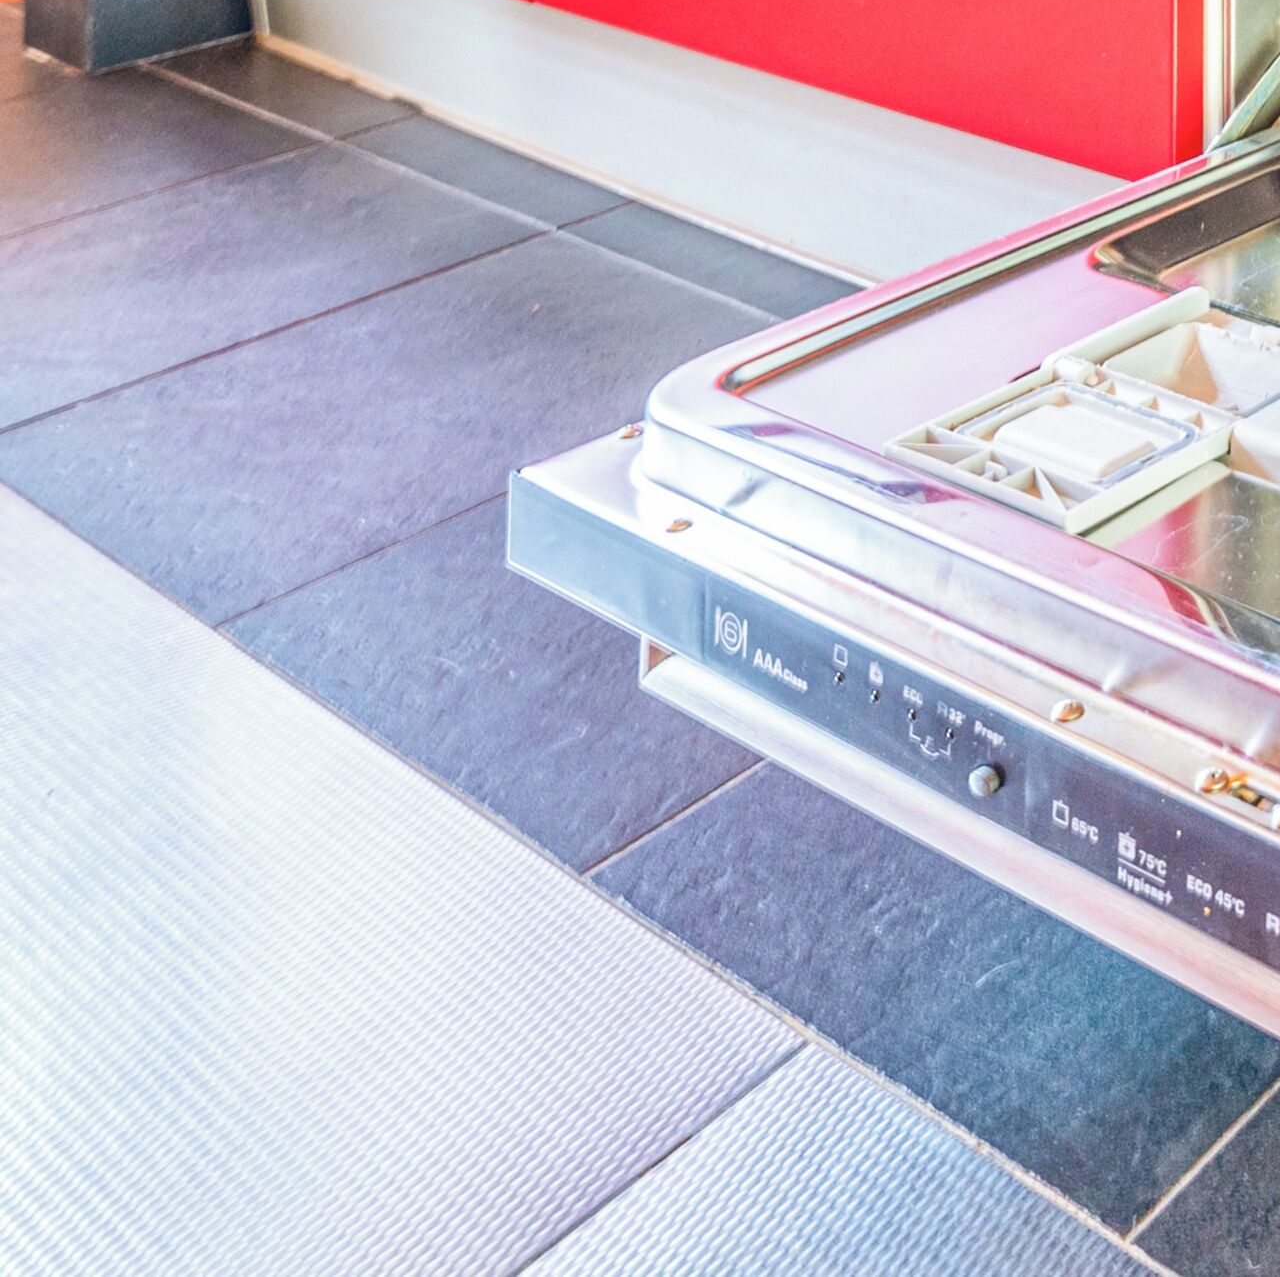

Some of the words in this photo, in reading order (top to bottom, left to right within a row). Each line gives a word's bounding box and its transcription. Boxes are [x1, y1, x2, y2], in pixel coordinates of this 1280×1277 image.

[1138, 849, 1167, 877] 75°C
[1186, 874, 1212, 900] ECO
[1215, 890, 1245, 917] 45°C
